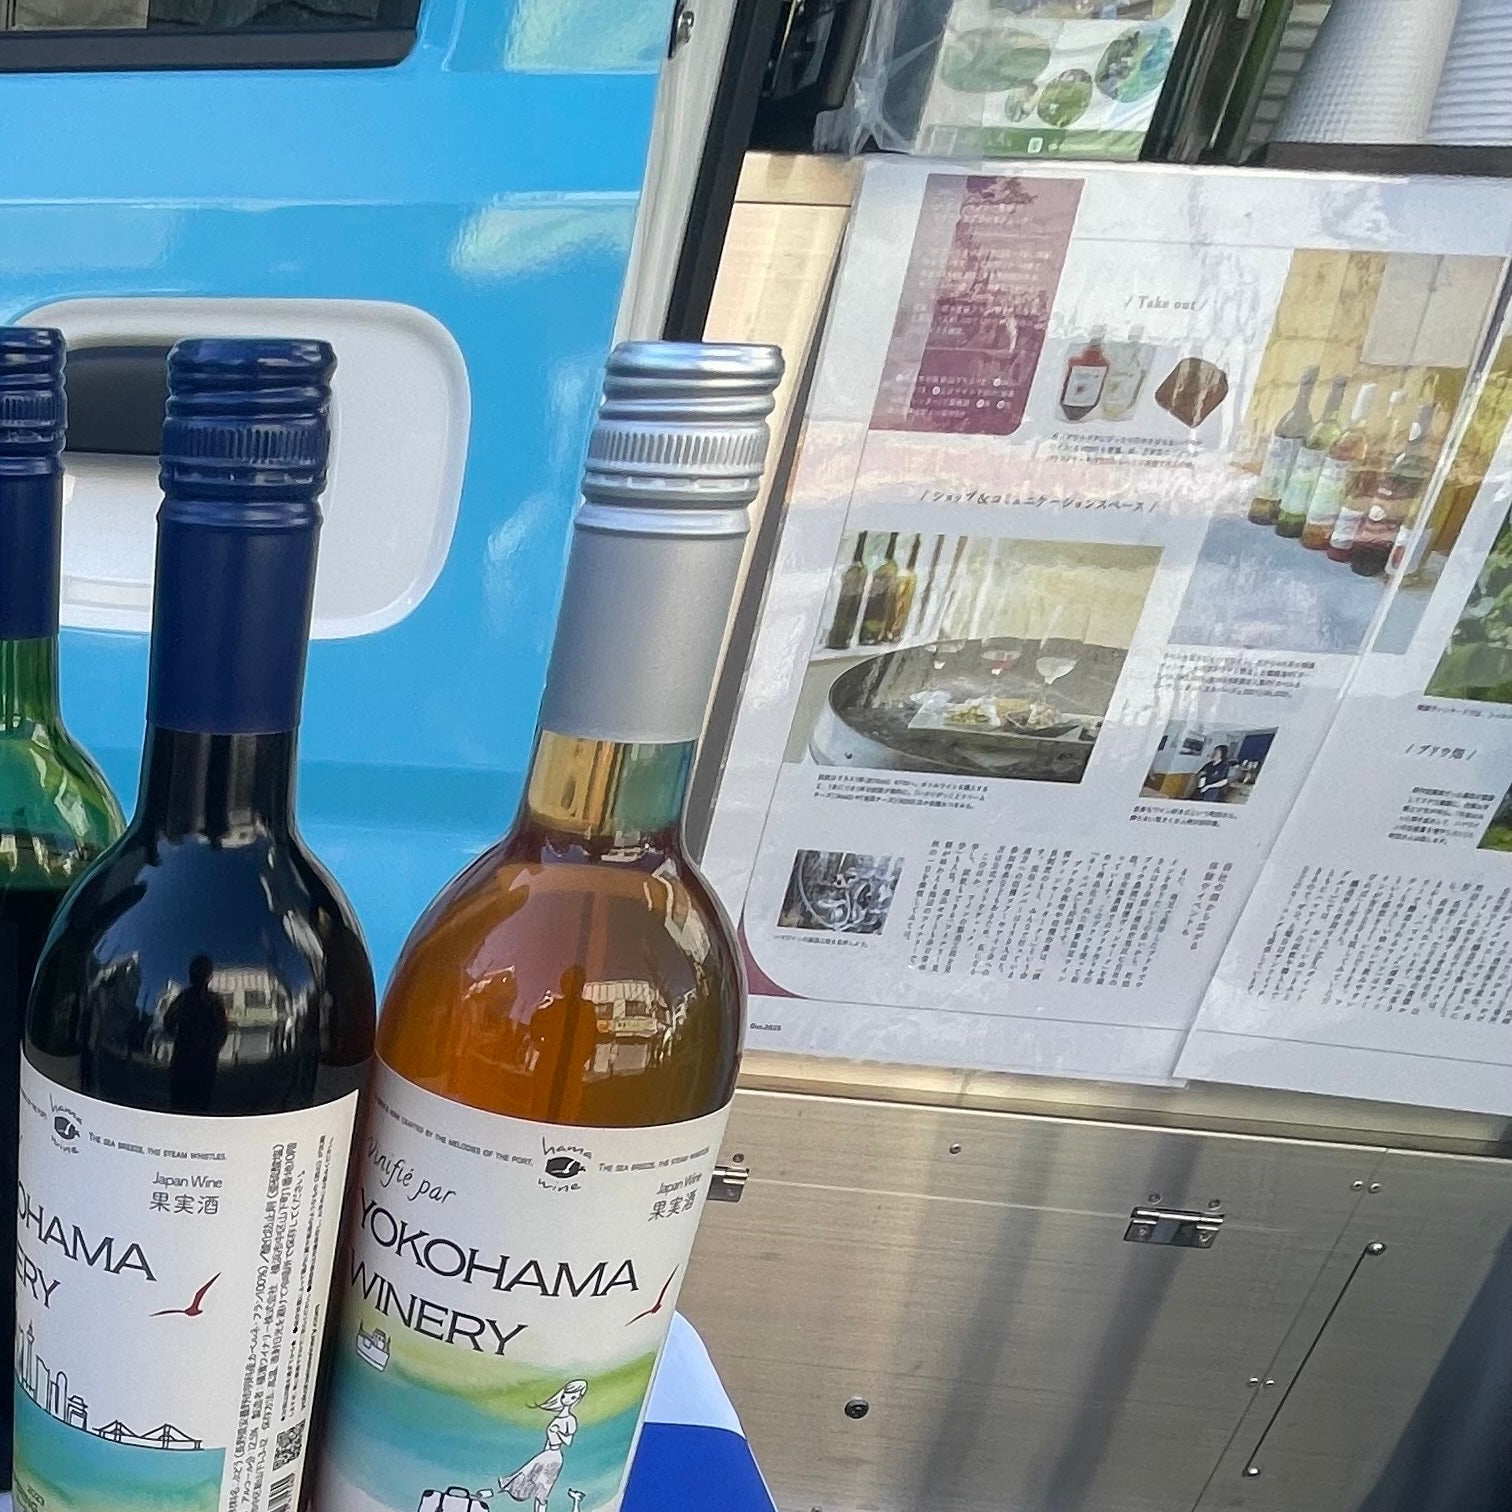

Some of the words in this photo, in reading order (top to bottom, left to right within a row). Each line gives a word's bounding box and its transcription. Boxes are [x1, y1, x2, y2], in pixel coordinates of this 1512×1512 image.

[542, 1136, 593, 1160] hama
[151, 1172, 188, 1189] Japan
[190, 1175, 223, 1188] Wine
[406, 1179, 457, 1204] par
[538, 1178, 581, 1193] wine
[149, 1191, 219, 1215] 果実酒
[357, 1188, 640, 1299] YOKOHAMA
[349, 1245, 529, 1357] WINERY
